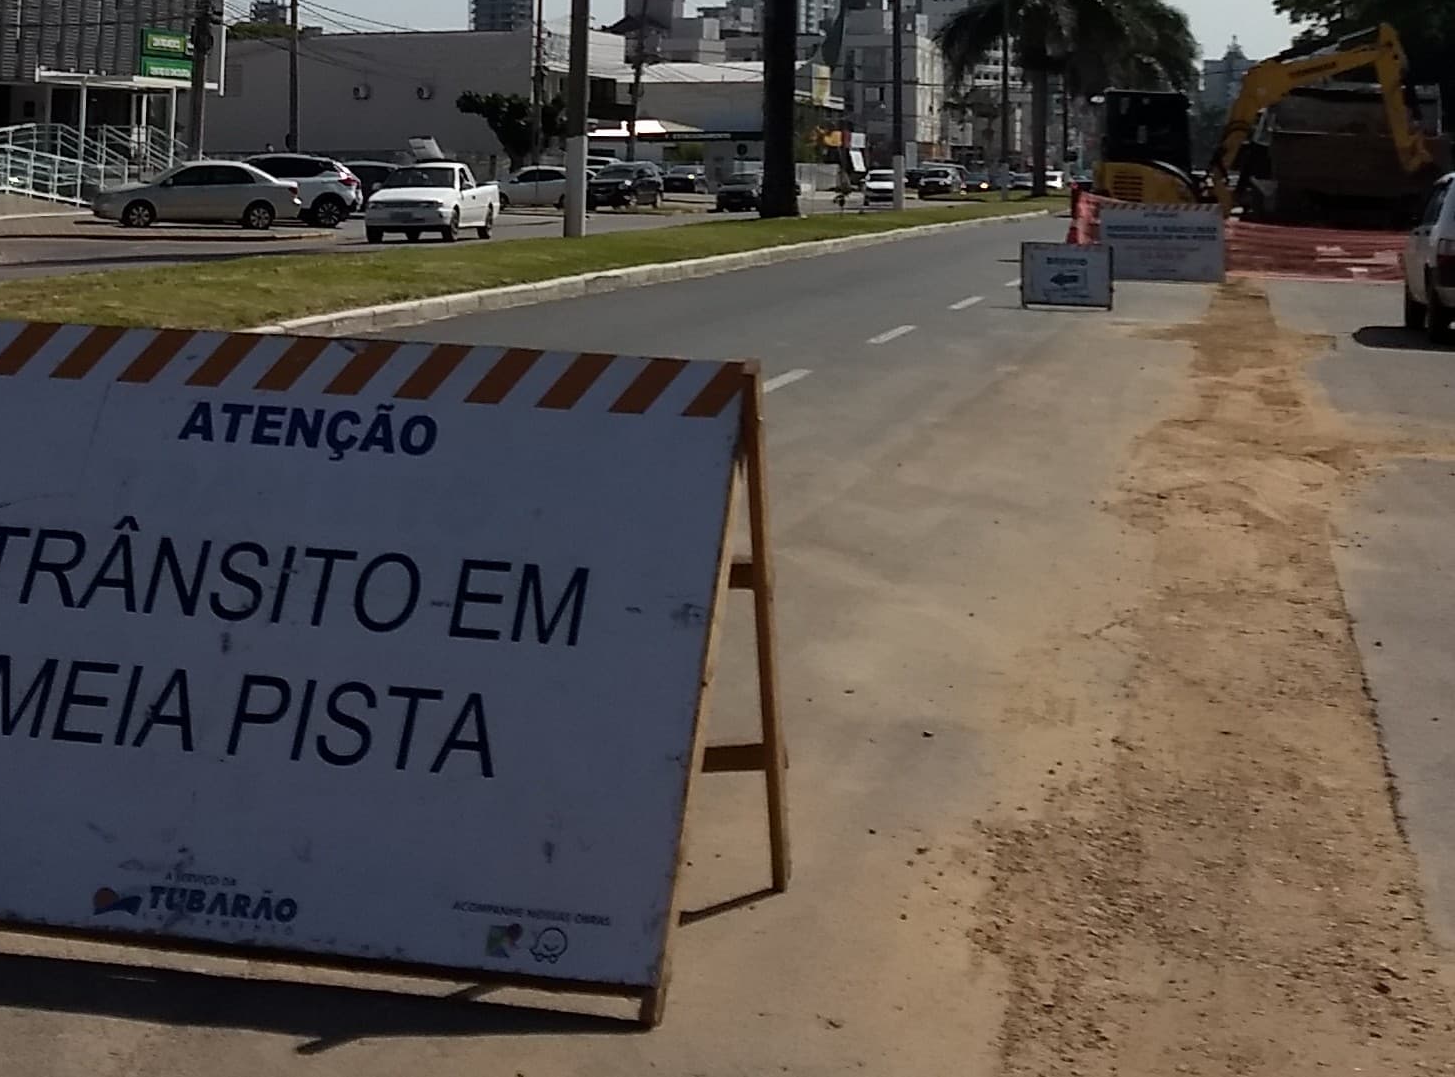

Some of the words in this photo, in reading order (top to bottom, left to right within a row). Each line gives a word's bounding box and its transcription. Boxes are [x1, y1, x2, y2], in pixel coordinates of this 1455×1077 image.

[177, 401, 440, 461] ATENÇÃO
[448, 558, 592, 647] EM
[226, 675, 497, 779] PISTA
[149, 884, 299, 923] TUBARÃO
